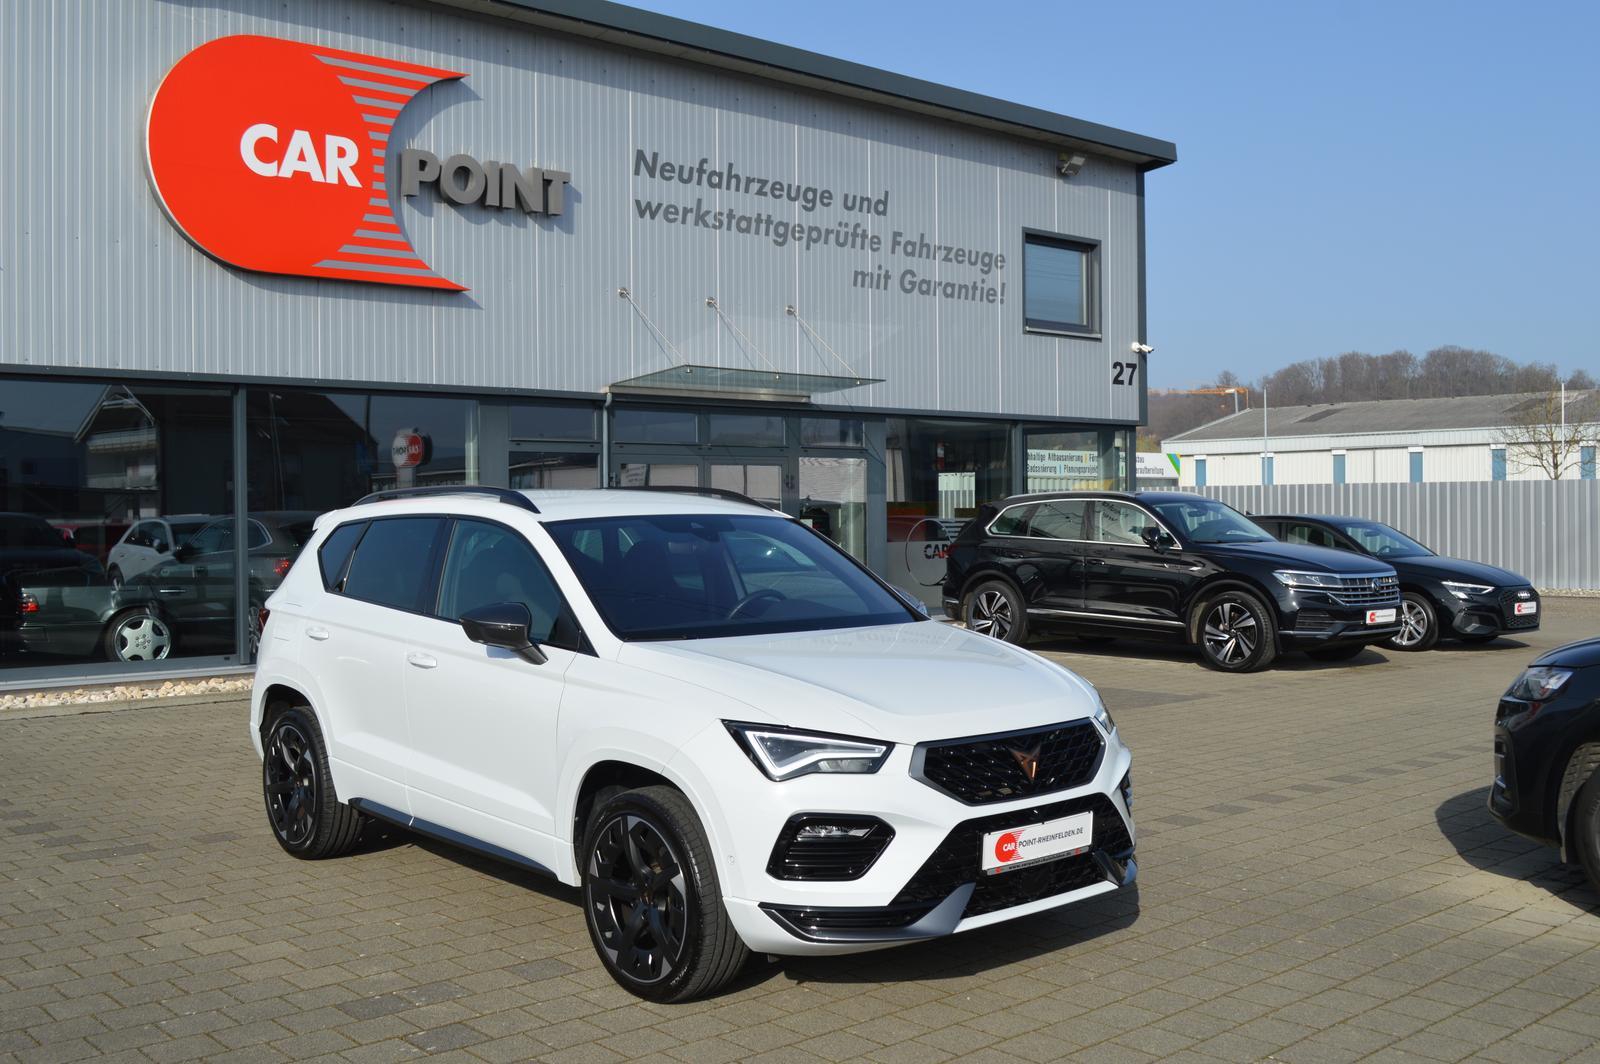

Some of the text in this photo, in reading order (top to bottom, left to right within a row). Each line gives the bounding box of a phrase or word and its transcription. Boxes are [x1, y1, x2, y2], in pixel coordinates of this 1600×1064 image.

[240, 123, 571, 216] CAR POINT
[634, 149, 889, 216] Neufahrzeuge und
[634, 198, 1006, 275] werkstattgeprüfte Fahrzeuge
[853, 264, 1006, 305] mit Garantie!
[1112, 361, 1138, 386] 27
[1002, 842, 1016, 852] CAR
